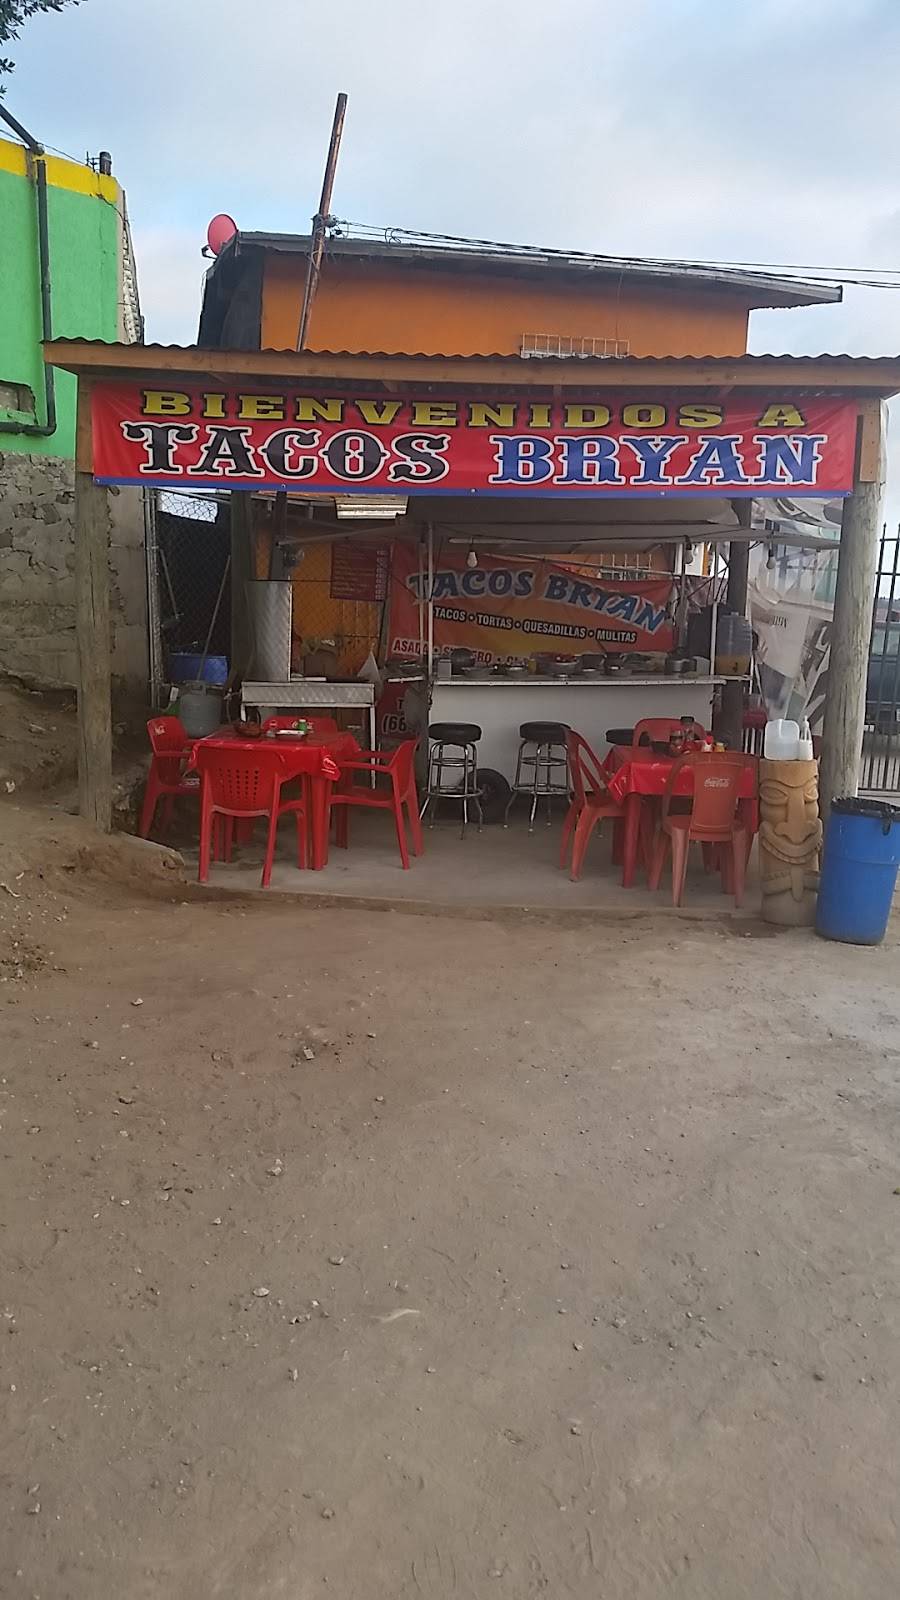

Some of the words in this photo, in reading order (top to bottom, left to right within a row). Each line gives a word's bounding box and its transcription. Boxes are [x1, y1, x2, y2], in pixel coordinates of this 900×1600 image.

[142, 390, 724, 428] BIENVENIDOS
[758, 402, 806, 428] A
[120, 421, 452, 483] TACOS
[489, 435, 828, 485] BRYAN
[406, 568, 534, 603] TACOS
[544, 573, 668, 634] BRYAN
[434, 606, 466, 621] TACOS
[477, 613, 512, 629] TORTAS
[523, 620, 586, 638] QUESADILLAS
[596, 629, 638, 643] MULITAS
